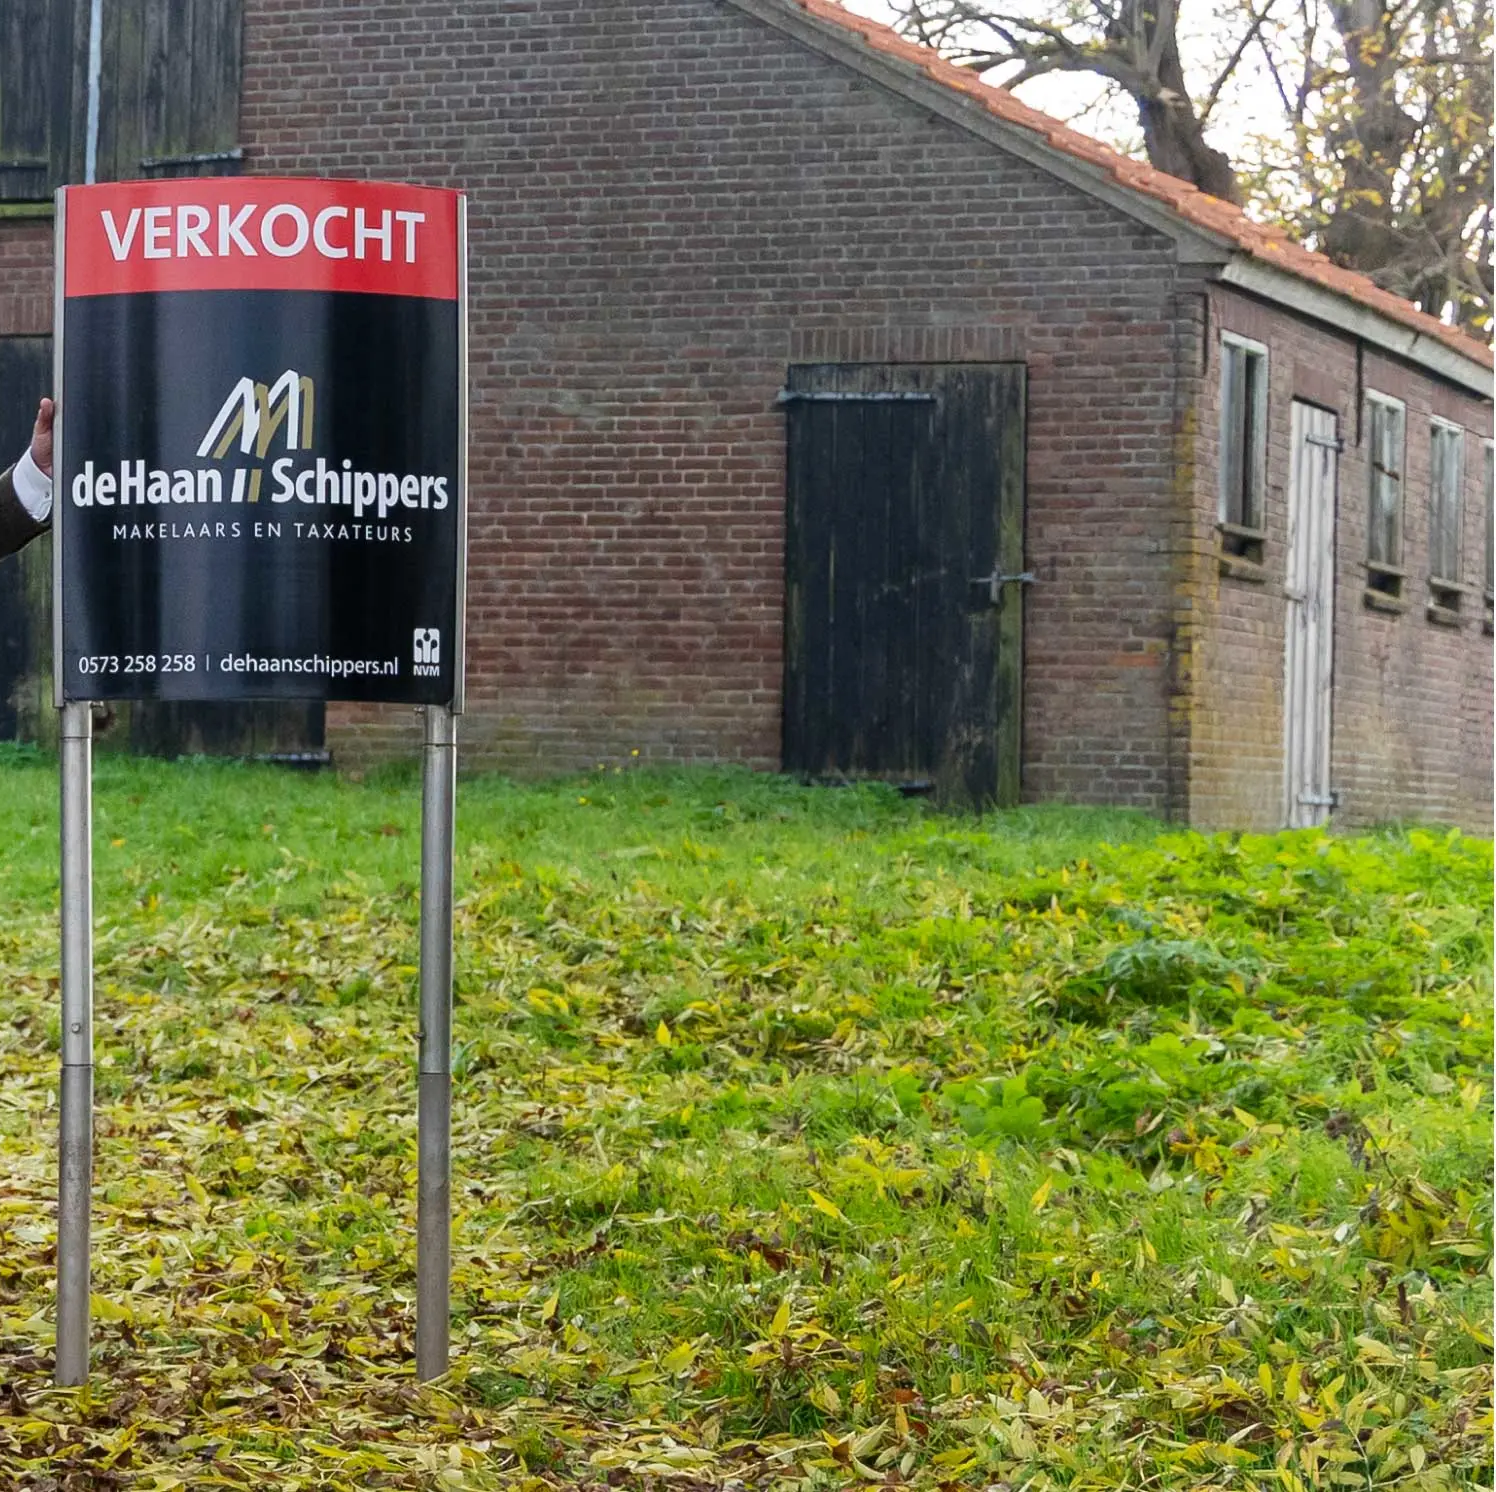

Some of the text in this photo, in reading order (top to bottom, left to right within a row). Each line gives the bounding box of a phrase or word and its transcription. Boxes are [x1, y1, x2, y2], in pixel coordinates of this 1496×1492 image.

[100, 203, 426, 263] VERKOCHT
[271, 457, 449, 518] Schippers
[113, 522, 413, 543] MAKELAARS EN TAXATEURS
[78, 653, 399, 677] 0573 258 258 dehaanschippers.nl
[413, 665, 440, 676] NVM
